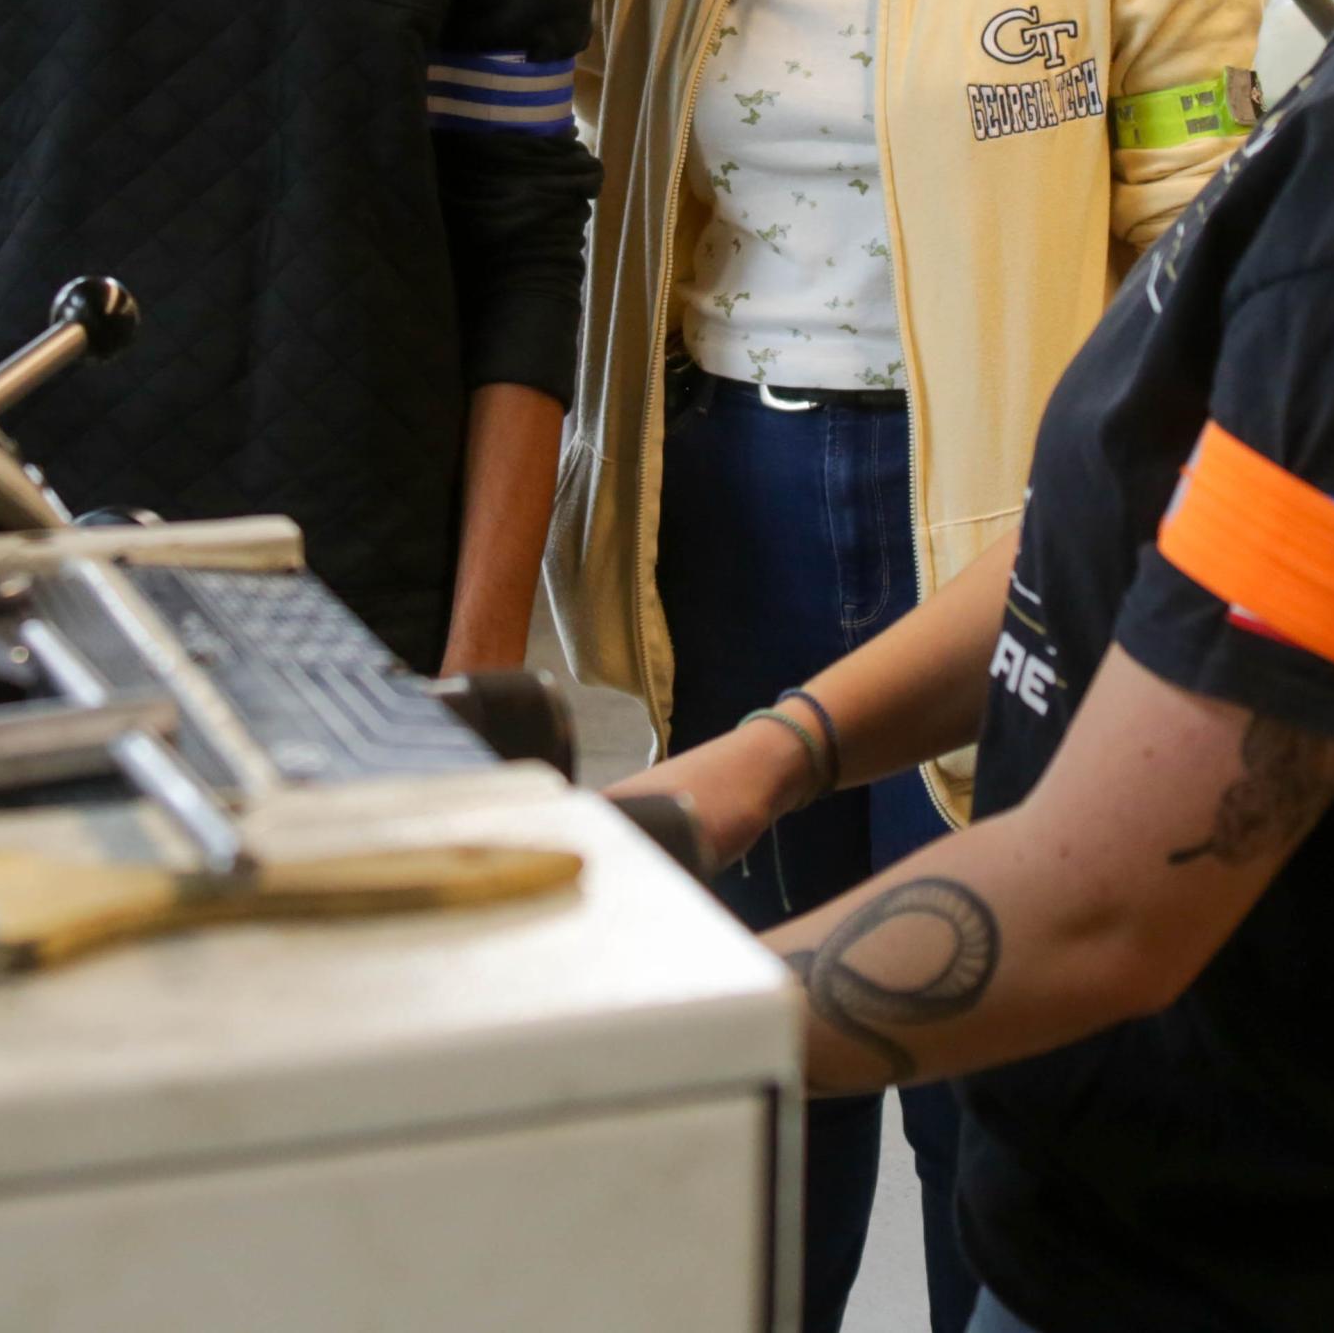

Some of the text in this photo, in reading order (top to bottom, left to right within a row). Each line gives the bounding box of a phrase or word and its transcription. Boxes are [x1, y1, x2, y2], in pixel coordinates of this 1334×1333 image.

[980, 5, 1078, 69] GT
[967, 81, 1059, 141] GEORGIA
[1054, 58, 1104, 122] TECH
